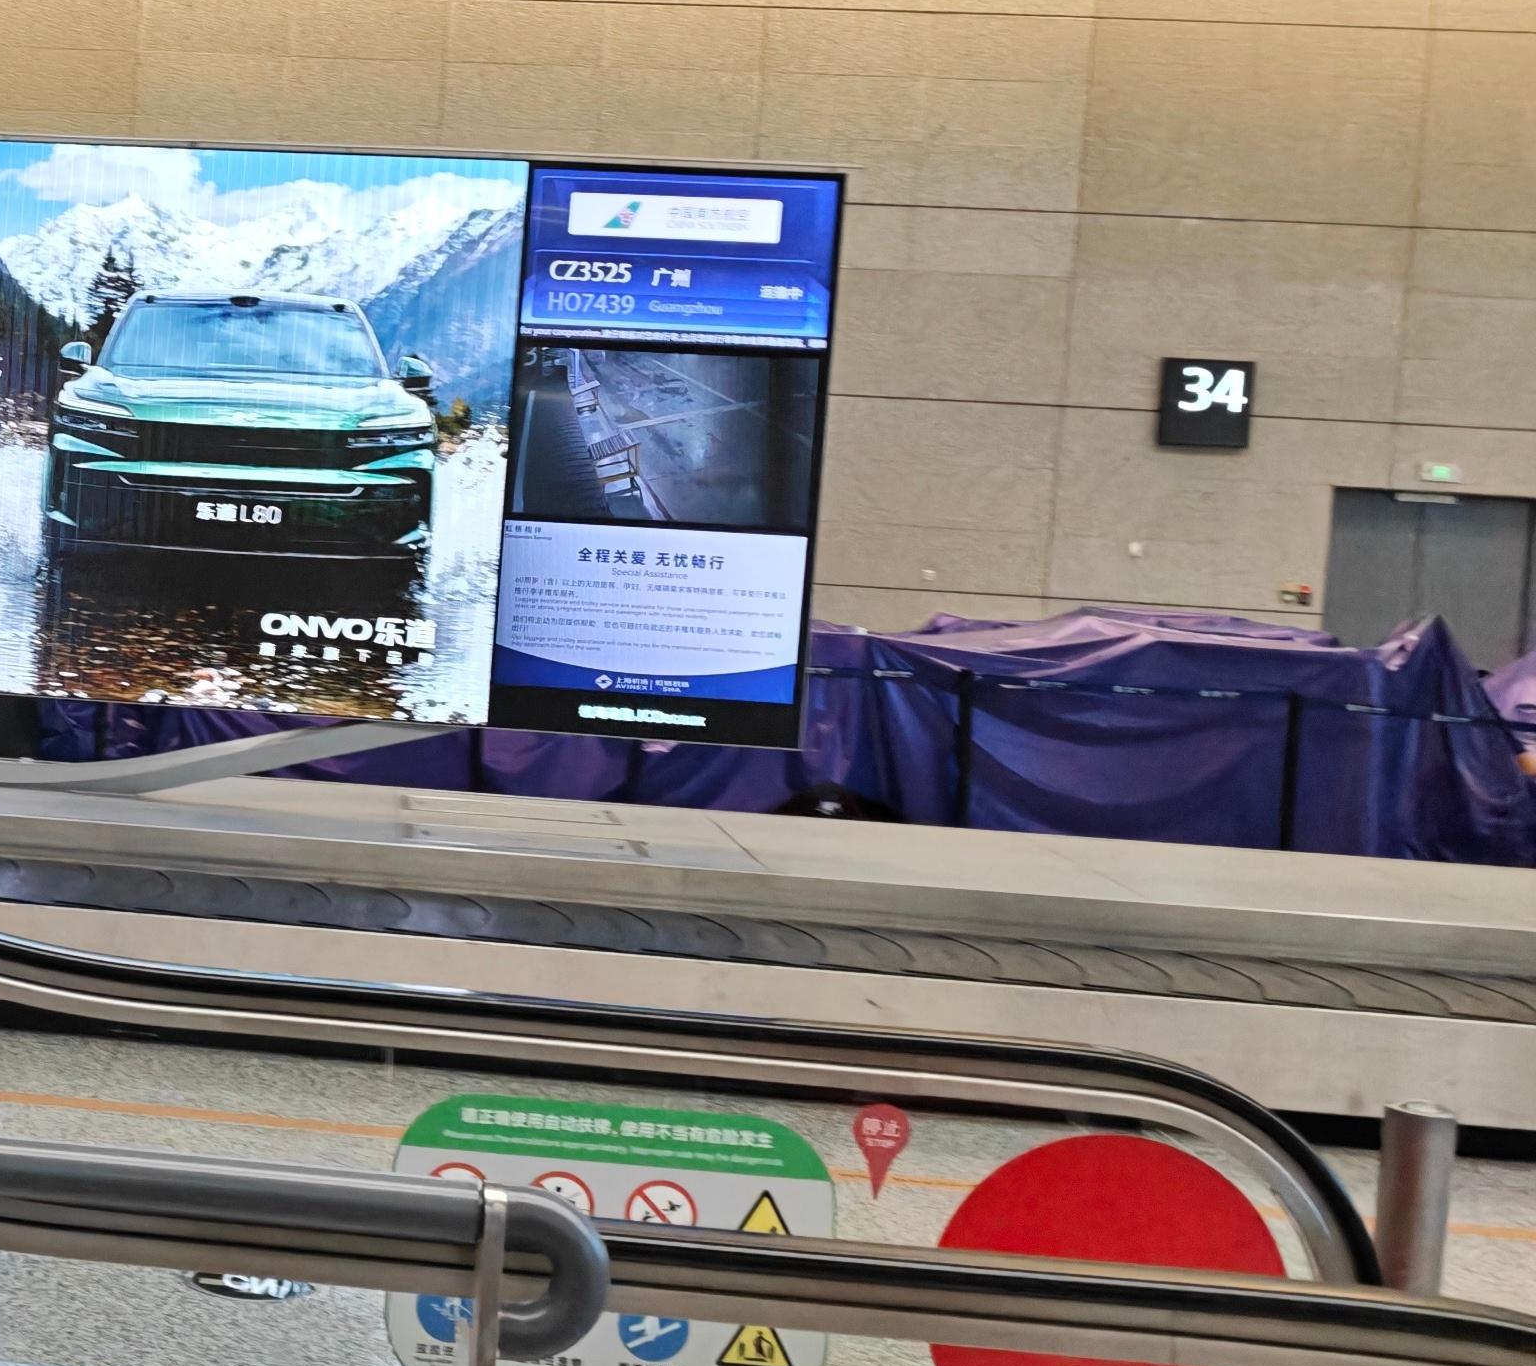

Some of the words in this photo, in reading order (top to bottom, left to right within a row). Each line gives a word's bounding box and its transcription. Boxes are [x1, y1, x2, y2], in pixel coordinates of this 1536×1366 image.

[548, 259, 633, 284] CZ3525
[547, 291, 636, 315] HO7439
[1177, 366, 1249, 413] 34
[577, 547, 647, 566] 全程关爱
[655, 552, 726, 571] 无忧畅行
[611, 568, 642, 579] Special
[643, 569, 689, 580] Assistance
[862, 1116, 901, 1137] 停止
